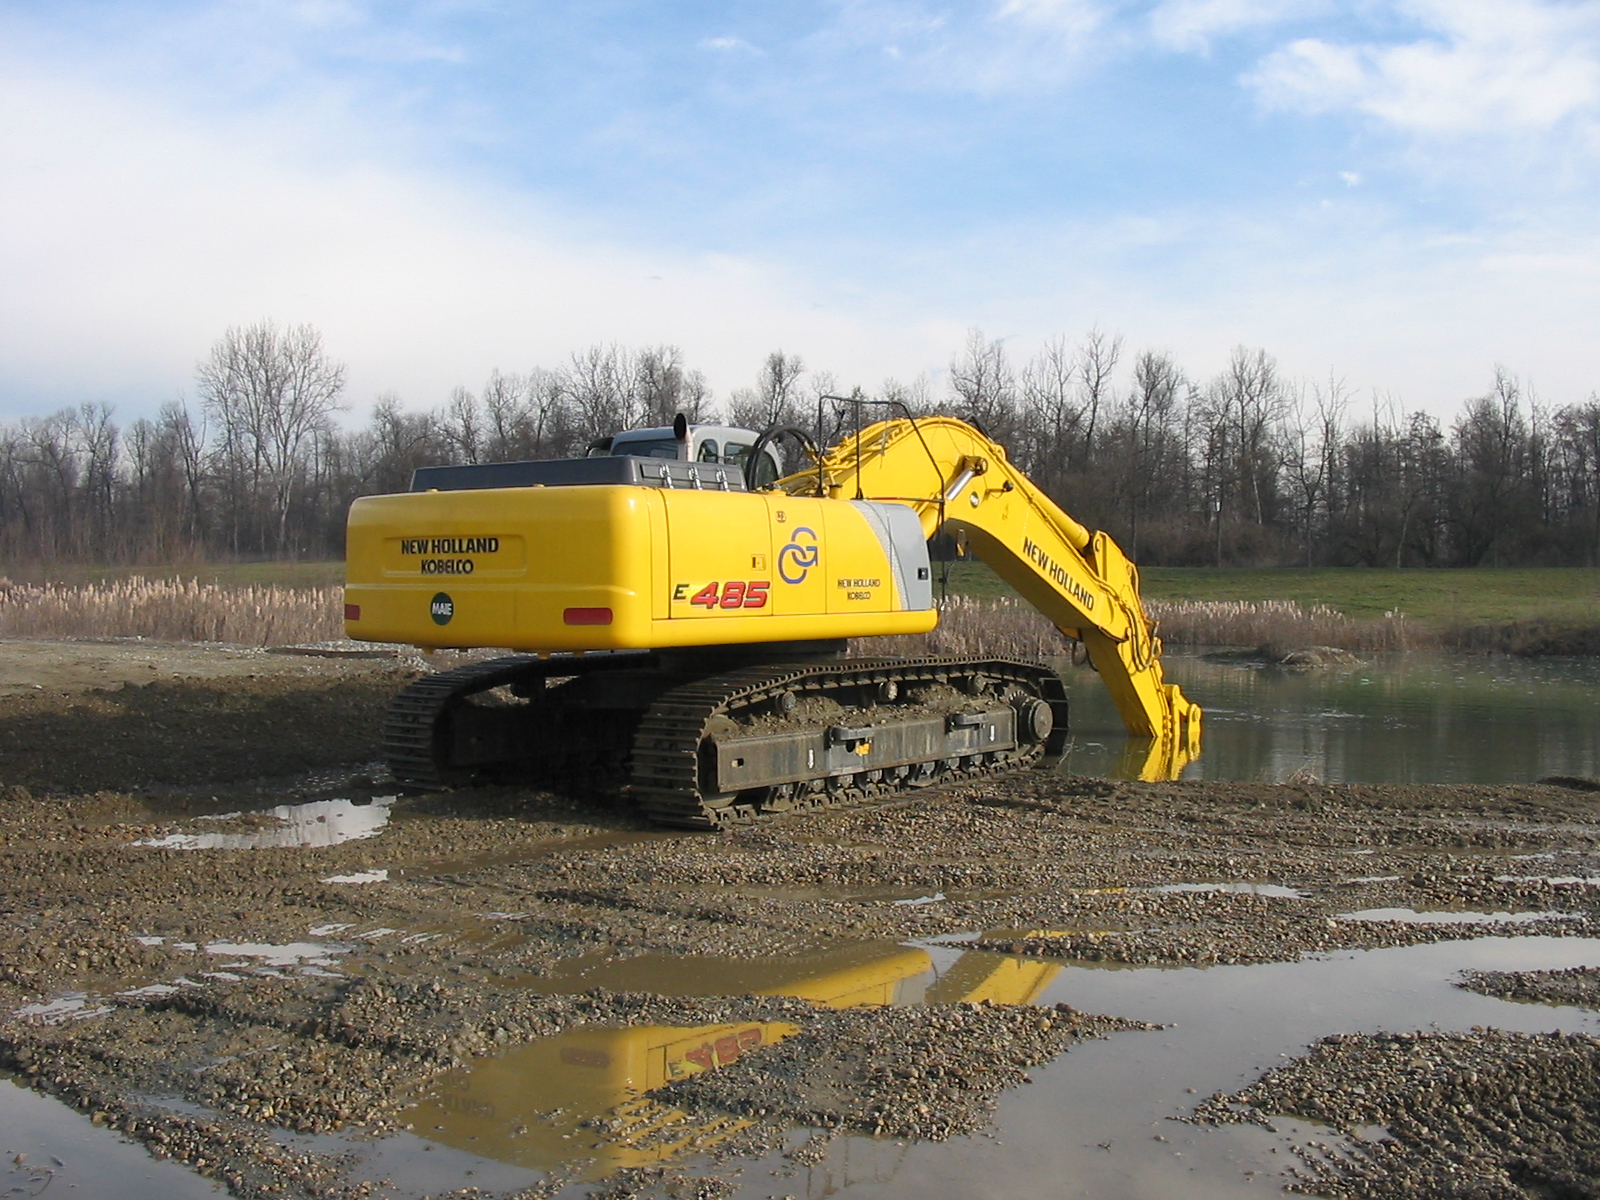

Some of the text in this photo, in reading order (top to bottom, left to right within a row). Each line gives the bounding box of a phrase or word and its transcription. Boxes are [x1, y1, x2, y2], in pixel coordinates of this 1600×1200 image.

[401, 537, 499, 554] NEW HOLLAND
[421, 559, 474, 574] KOBELCO
[1023, 536, 1095, 611] NEW HOLLAND
[837, 578, 881, 588] NEW HOLLAND
